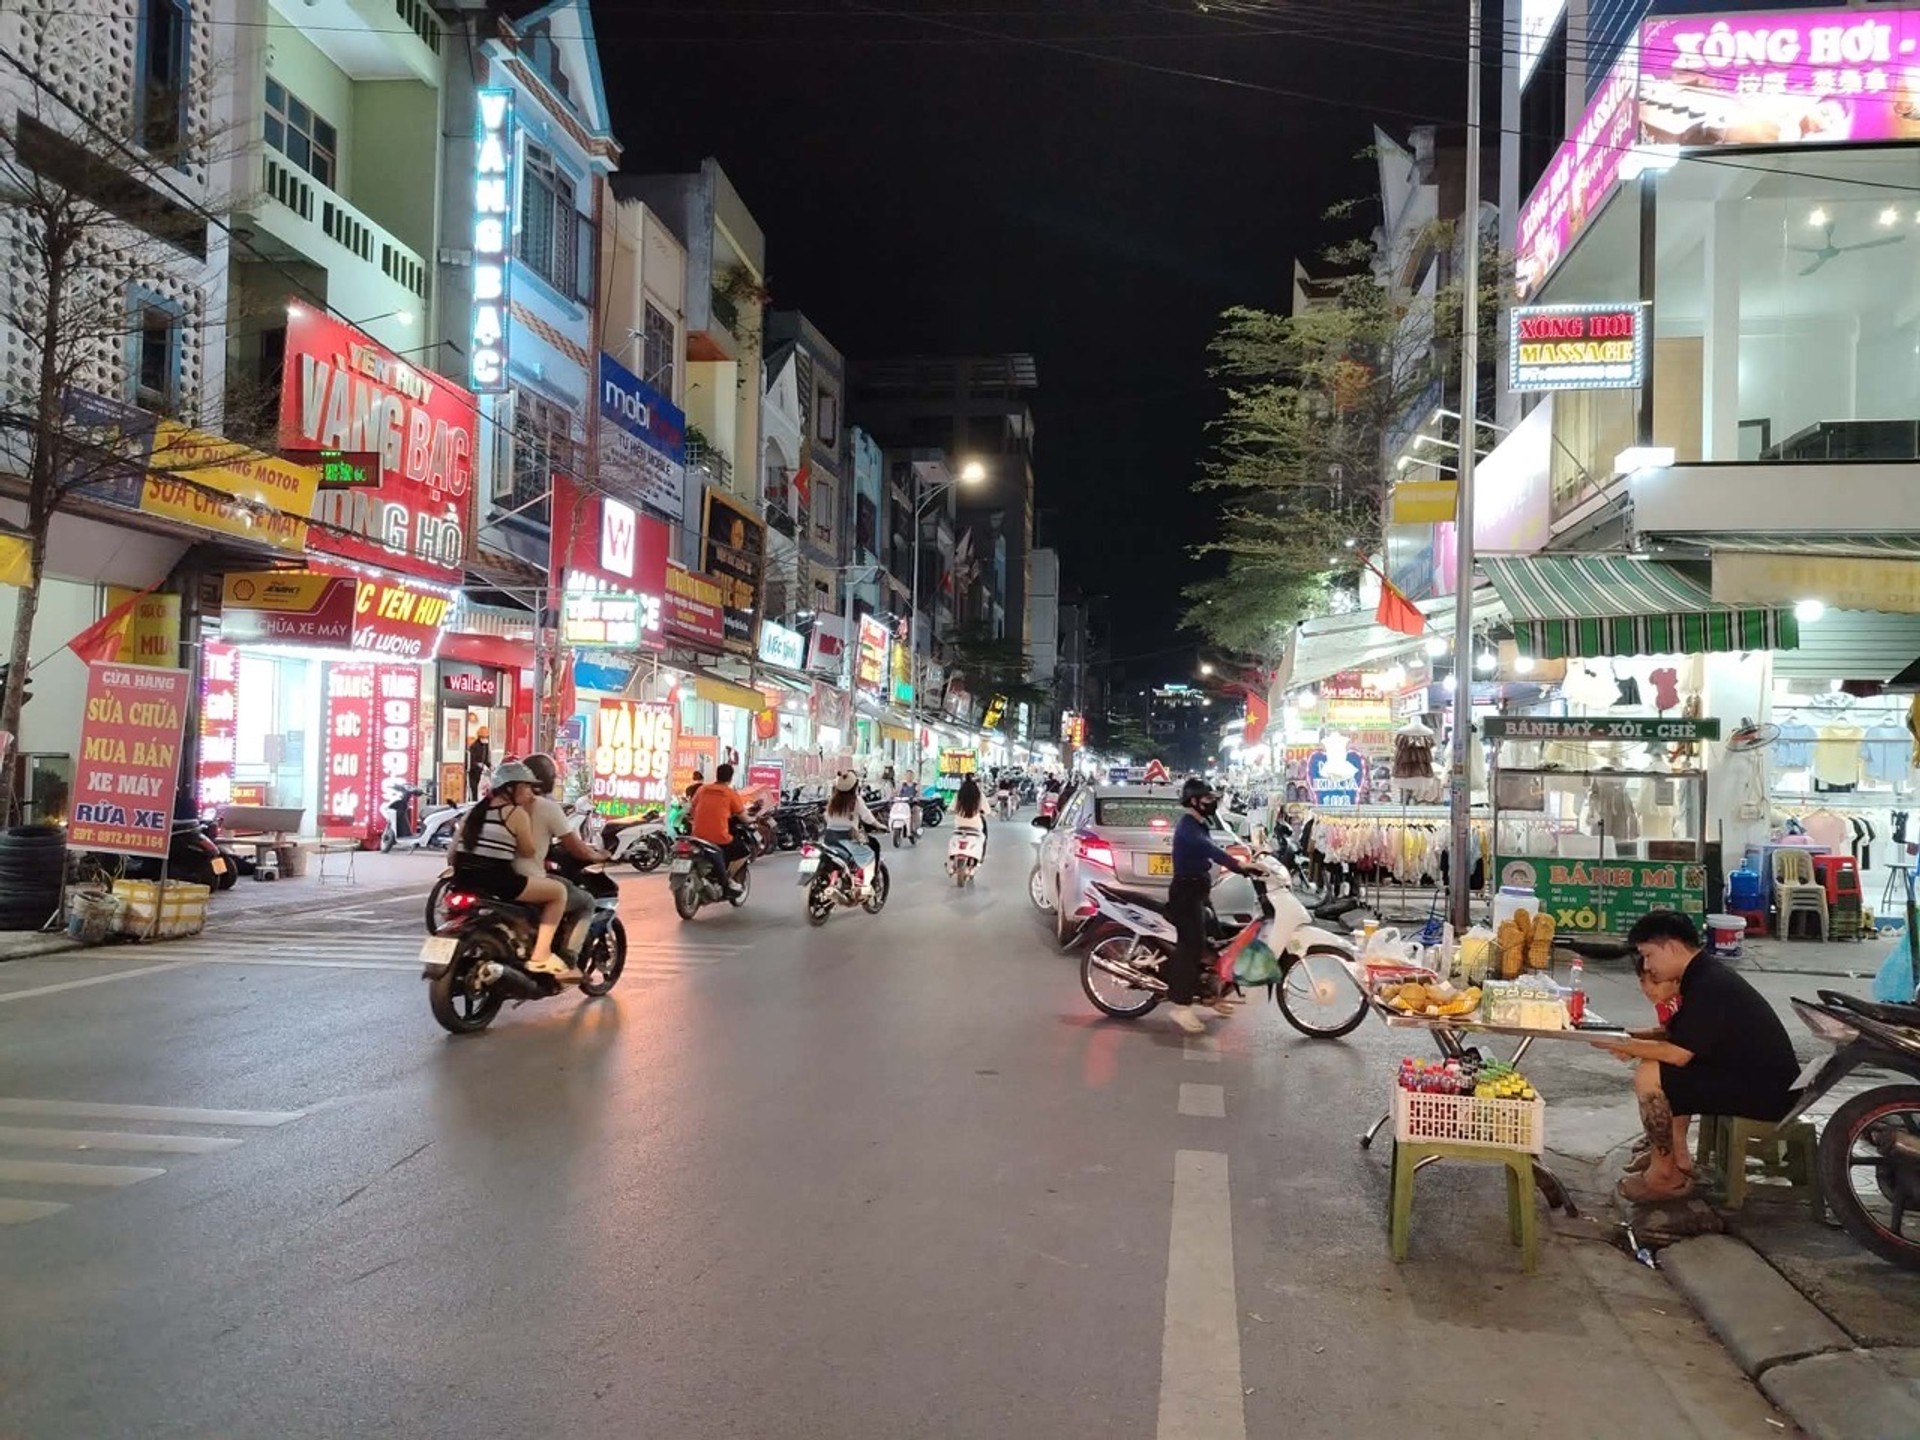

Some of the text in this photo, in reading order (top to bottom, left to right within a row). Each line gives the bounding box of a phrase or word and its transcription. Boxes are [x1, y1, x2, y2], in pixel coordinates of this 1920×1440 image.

[1671, 19, 1892, 70] XÔNG HƠI
[1519, 313, 1634, 339] XÔNG HƠI
[1519, 340, 1633, 364] MASSAGE
[395, 363, 433, 404] HUY
[301, 352, 470, 502] VÀNG BẠC
[255, 465, 300, 494] MOTOR
[416, 502, 462, 569] HỒ
[608, 513, 632, 562] W
[377, 582, 417, 622] YẾN
[299, 622, 314, 635] XE
[318, 620, 347, 637] MÁY
[134, 673, 175, 690] HÀNG
[450, 674, 496, 694] wallace
[87, 690, 179, 729] SỬA CHỮA
[599, 701, 673, 750] VÀNG
[1505, 720, 1696, 738] BÁNH MỲ XÔI CHÈ
[84, 736, 175, 769] MUA BÁN
[333, 753, 358, 777] CAO
[595, 746, 669, 779] 9999
[87, 770, 163, 797] XE MÁY
[132, 808, 166, 830] XE
[1550, 862, 1677, 889] BÁNH MÌ
[1556, 906, 1606, 929] XÔI
